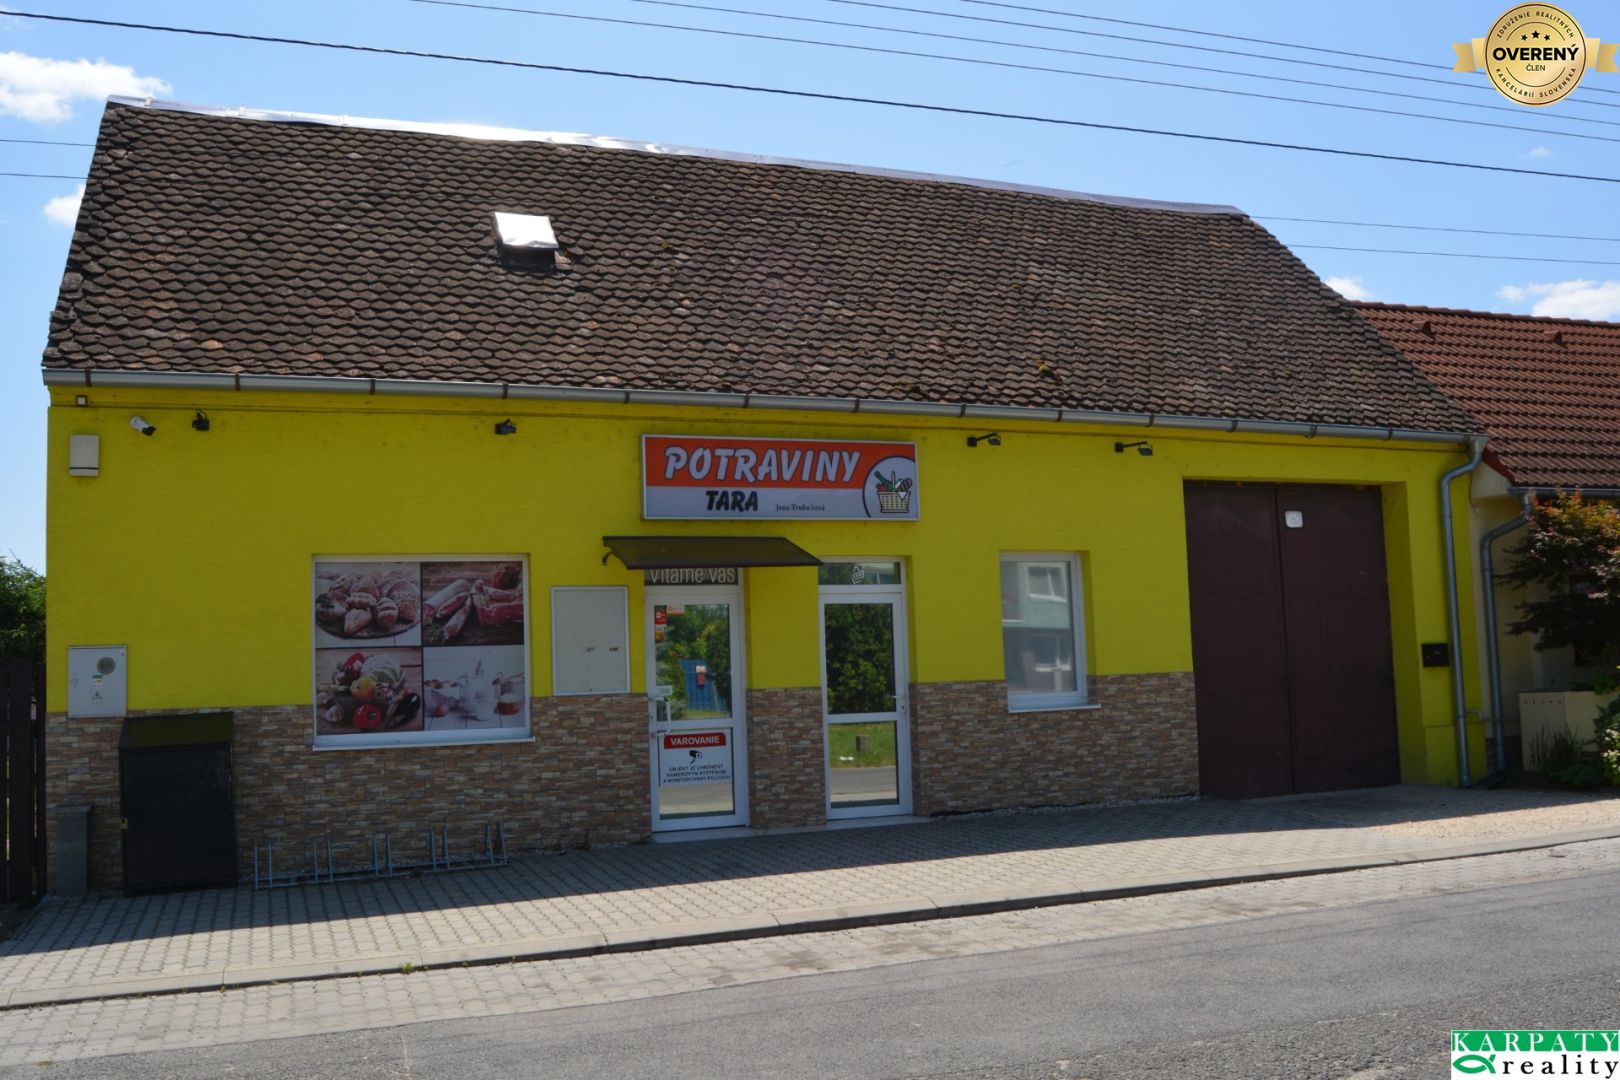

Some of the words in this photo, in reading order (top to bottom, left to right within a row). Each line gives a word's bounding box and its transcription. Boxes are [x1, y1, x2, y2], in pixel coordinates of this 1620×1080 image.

[664, 445, 861, 483] POTRAVINY
[705, 490, 759, 512] TARA
[775, 503, 790, 512] Jana
[670, 735, 721, 746] VAROVANIE
